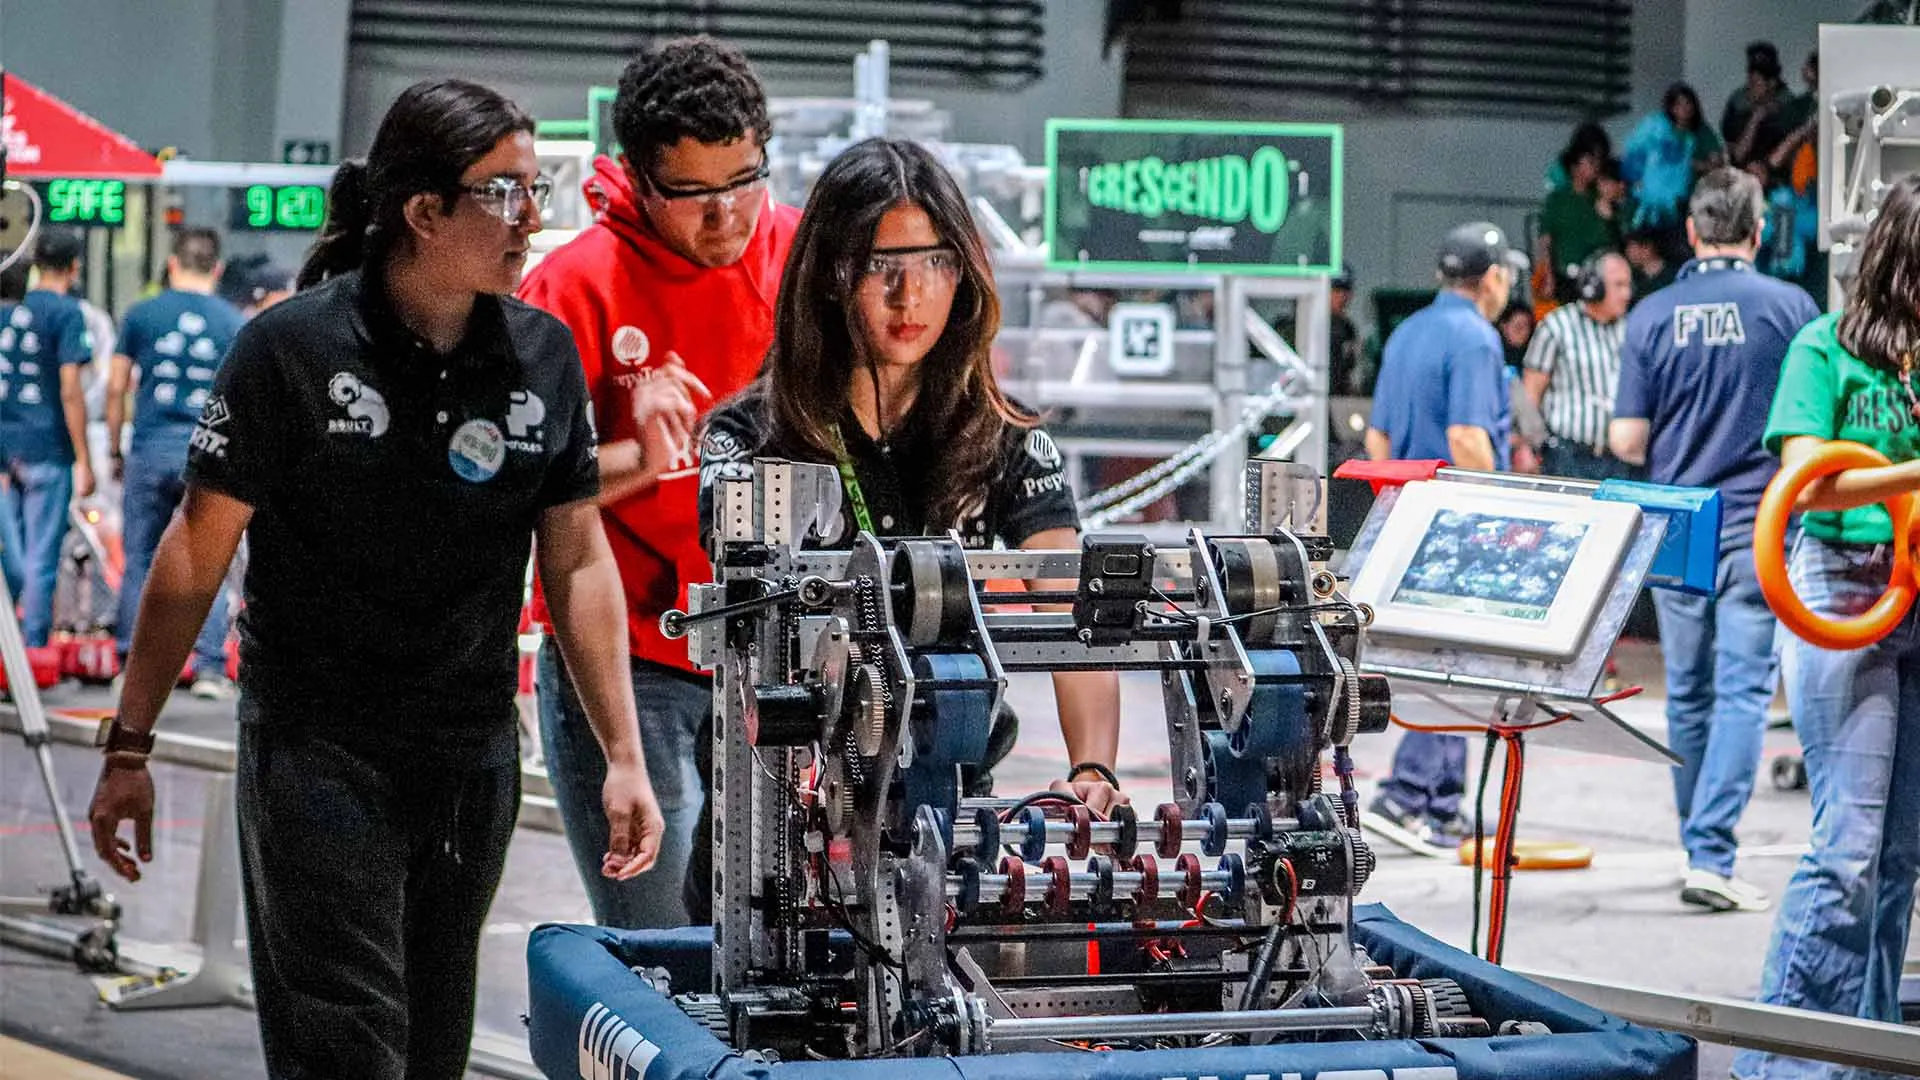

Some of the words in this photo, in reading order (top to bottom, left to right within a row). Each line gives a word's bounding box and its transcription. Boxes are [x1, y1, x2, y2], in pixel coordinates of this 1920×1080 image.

[49, 179, 124, 222] SAFE
[1088, 145, 1289, 234] CRESCENDO
[1674, 302, 1746, 347] FTA
